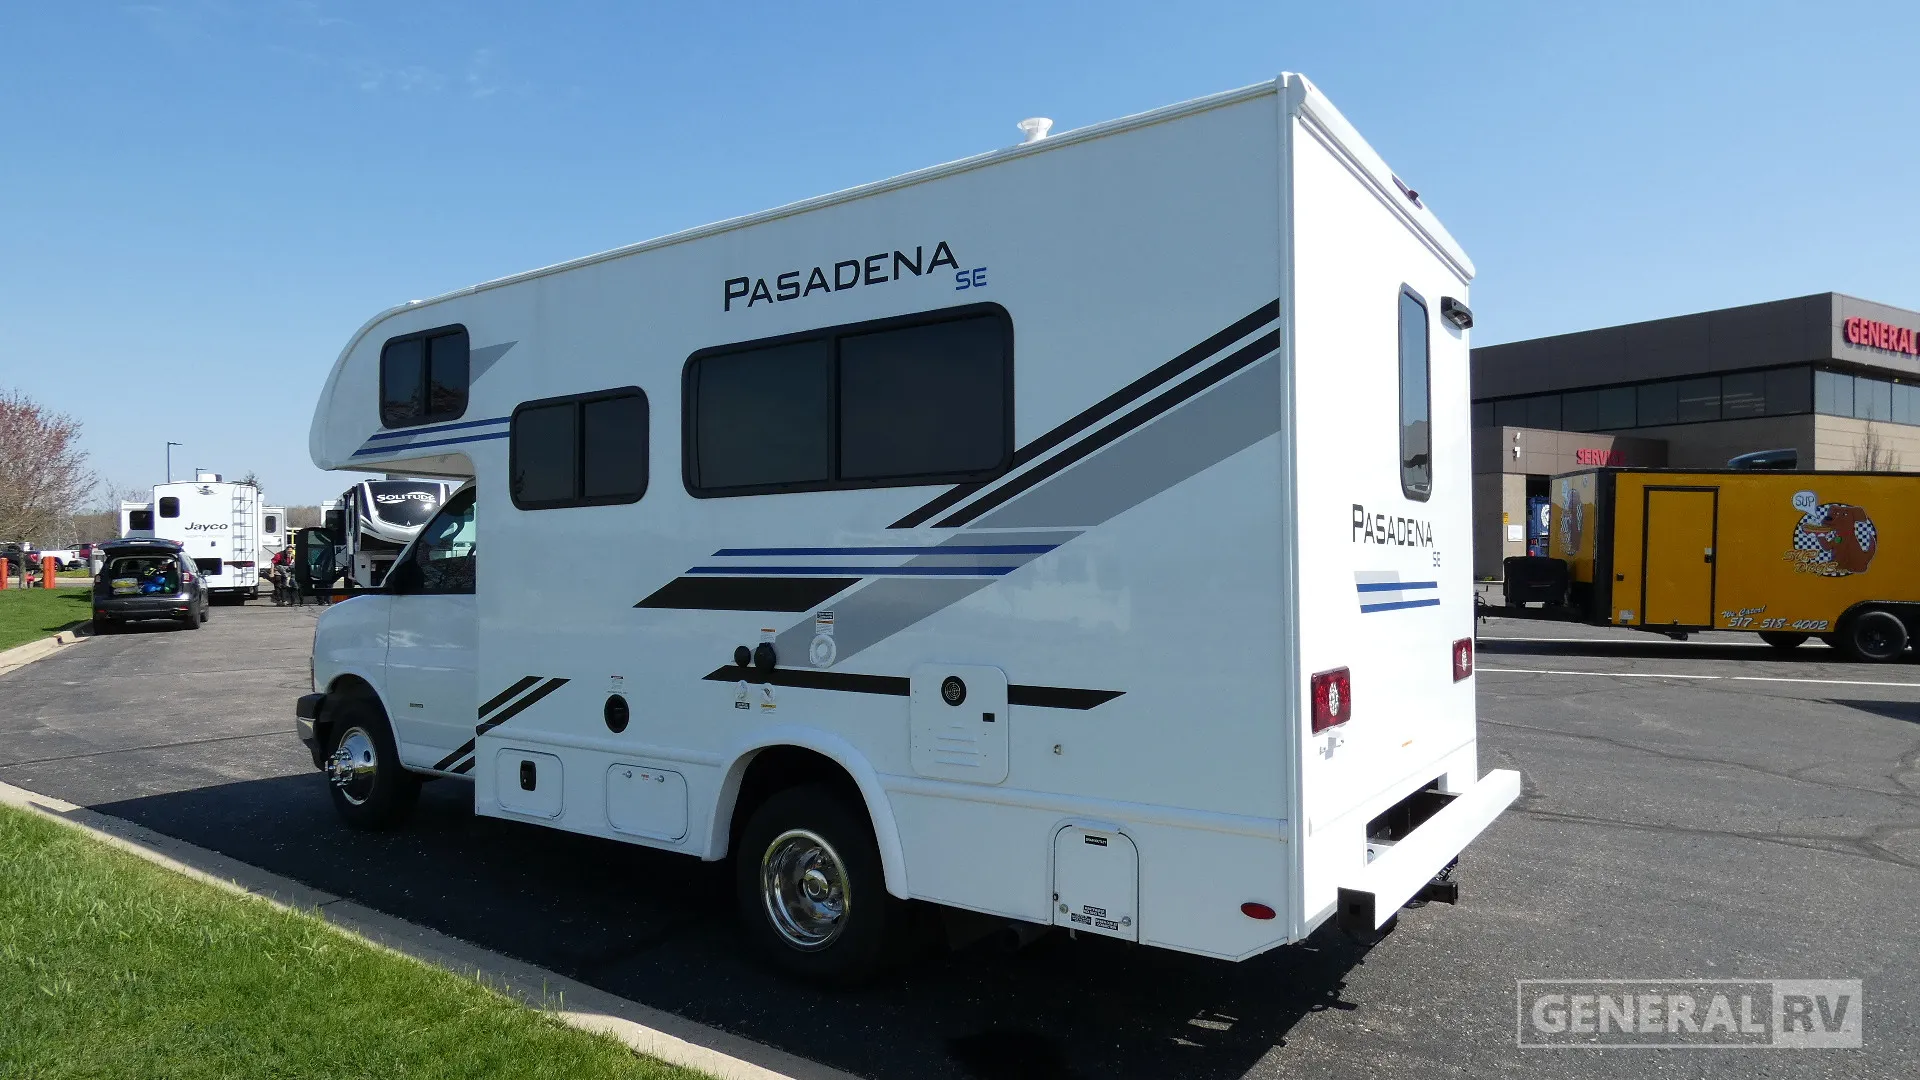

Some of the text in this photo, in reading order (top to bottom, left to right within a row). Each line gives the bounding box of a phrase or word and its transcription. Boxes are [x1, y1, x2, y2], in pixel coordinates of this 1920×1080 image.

[724, 241, 959, 312] PASADENA
[955, 266, 988, 291] SE
[1844, 316, 1917, 355] GENERAL
[1576, 448, 1626, 467] SERVICE
[376, 493, 437, 503] SOLITUDE
[1795, 495, 1815, 507] SUP
[184, 522, 229, 532] Jayco
[1352, 503, 1434, 548] PASADENA
[1432, 551, 1441, 567] SE
[1782, 549, 1819, 562] SUP
[1721, 610, 1735, 618] We
[1727, 617, 1829, 631] 517-518-4002
